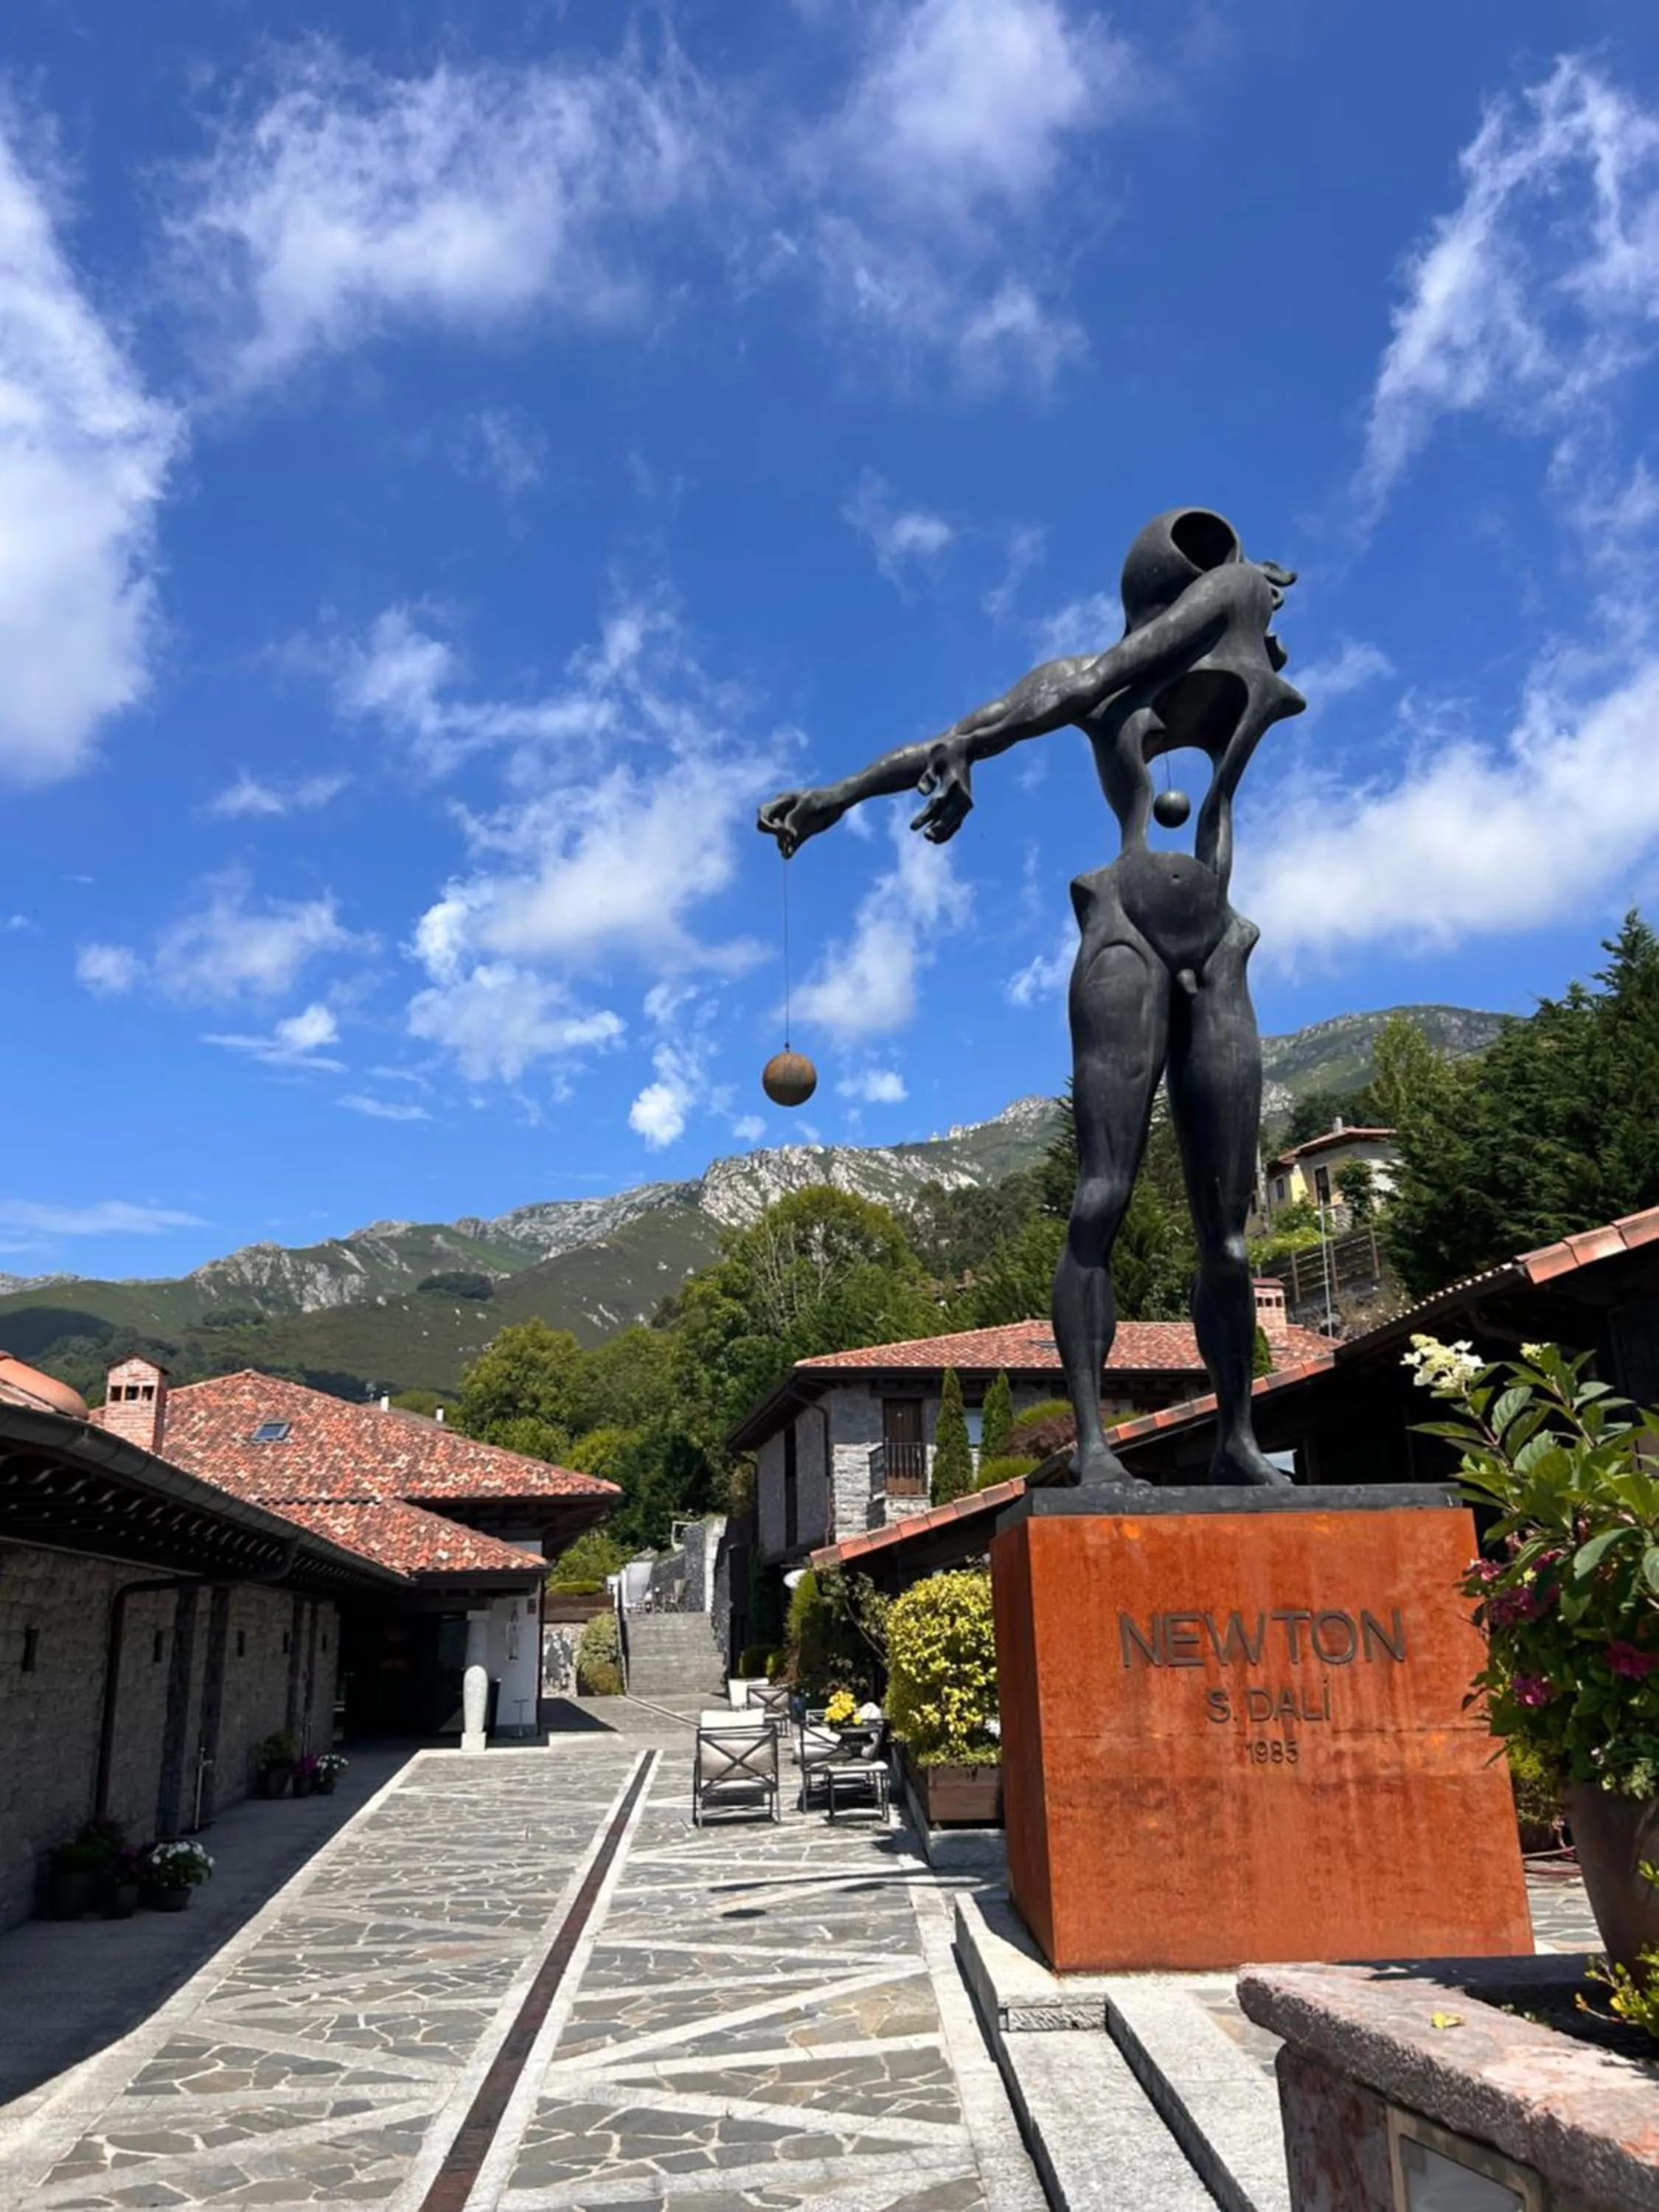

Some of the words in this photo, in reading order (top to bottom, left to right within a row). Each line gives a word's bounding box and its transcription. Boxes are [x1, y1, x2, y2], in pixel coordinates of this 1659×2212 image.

[1118, 1608, 1406, 1667] NEWTON
[1206, 1687, 1239, 1723] S.
[1247, 1740, 1300, 1764] 1985
